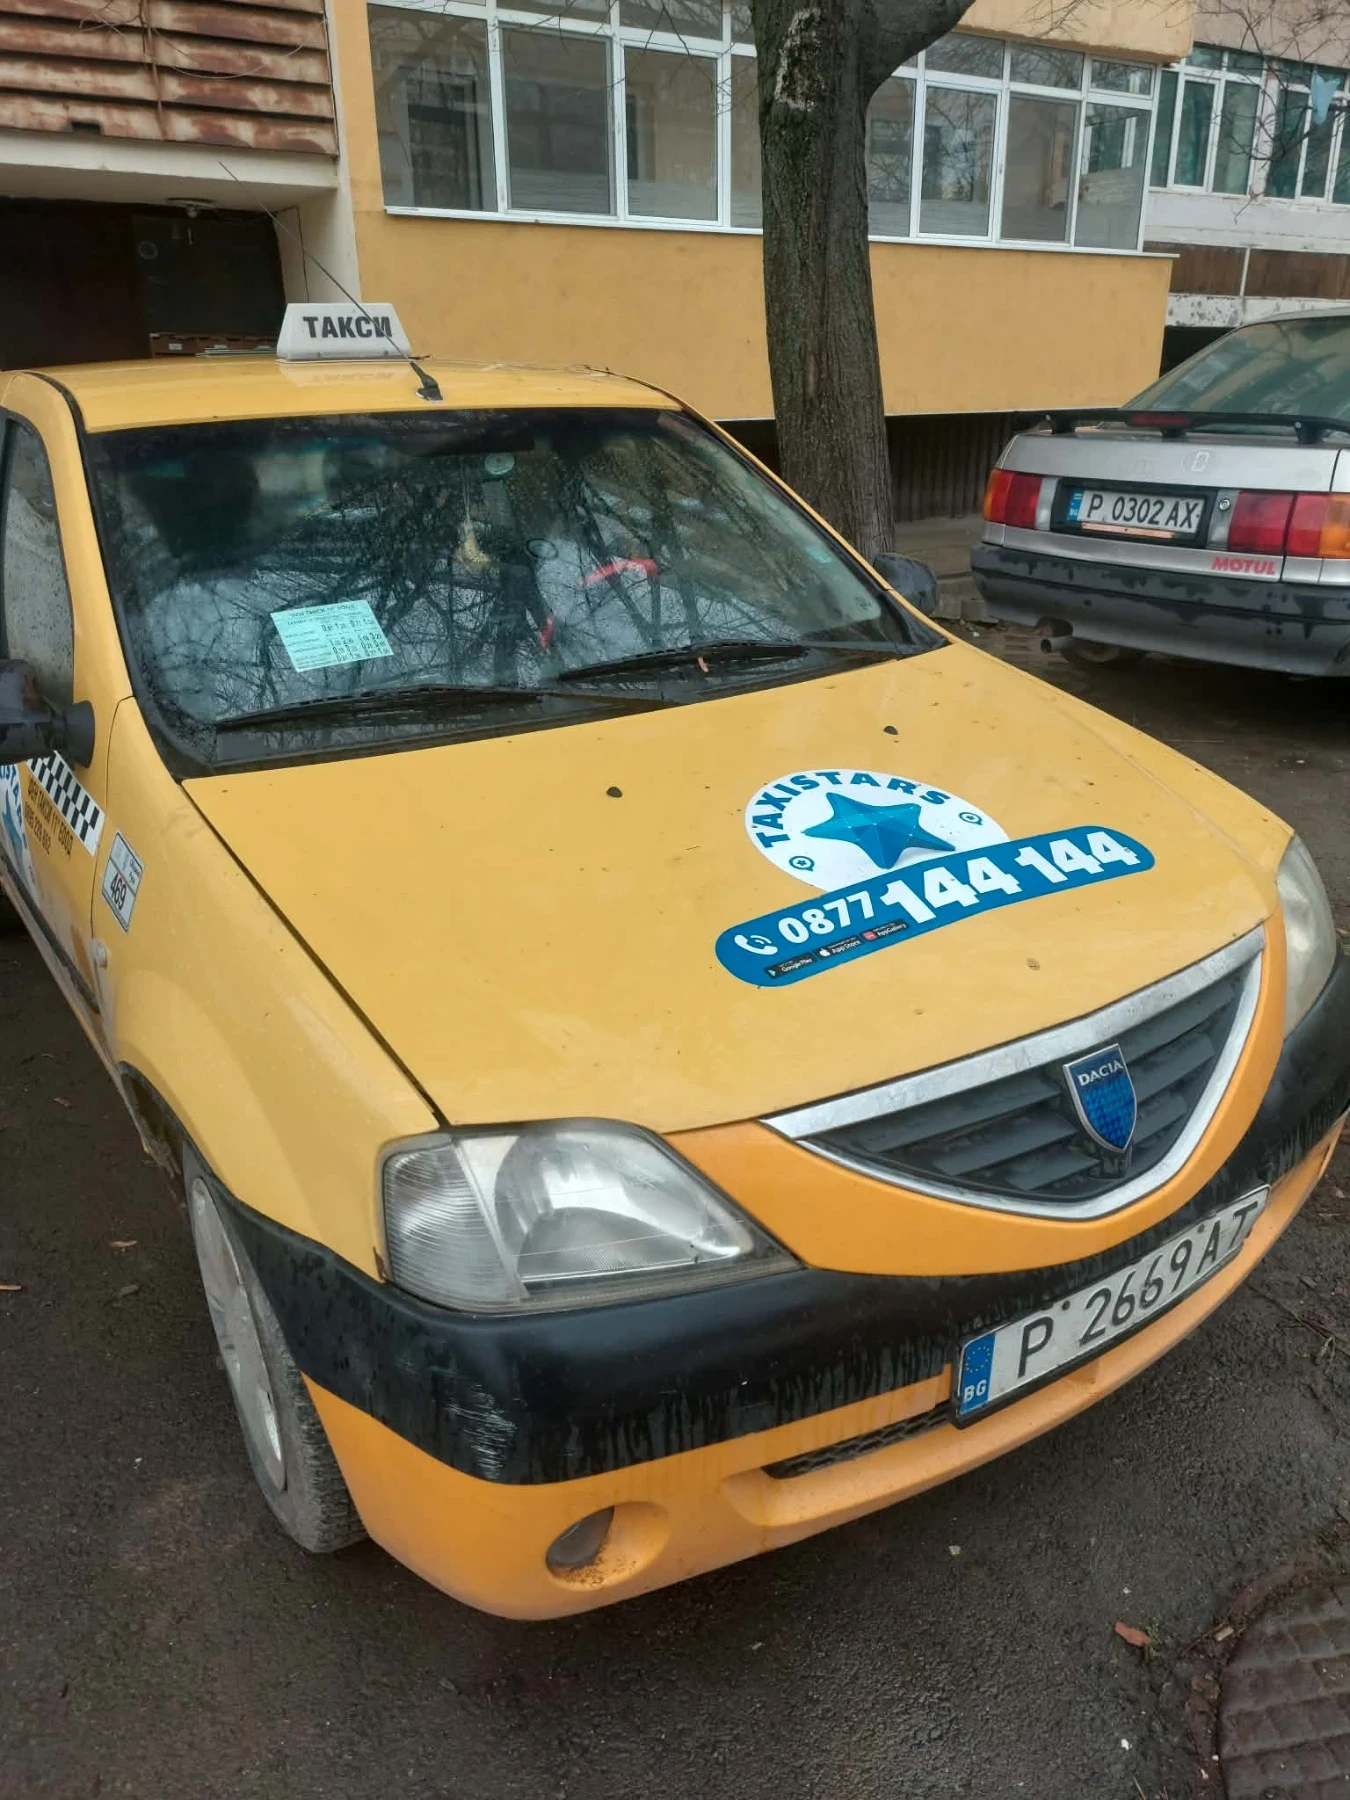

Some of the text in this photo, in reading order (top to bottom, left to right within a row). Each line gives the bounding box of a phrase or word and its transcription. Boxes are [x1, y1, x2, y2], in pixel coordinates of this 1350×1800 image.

[302, 316, 393, 338] ТАКСИ
[1087, 494, 1198, 529] P 0302 AX
[1211, 556, 1276, 575] MOTUL
[752, 771, 951, 848] TAXISTARS
[110, 872, 127, 911] 469
[778, 831, 1141, 944] 0877 144 144
[1077, 1060, 1124, 1086] DACIA
[1017, 1201, 1258, 1378] P 2669 AT
[964, 1379, 987, 1401] BG
